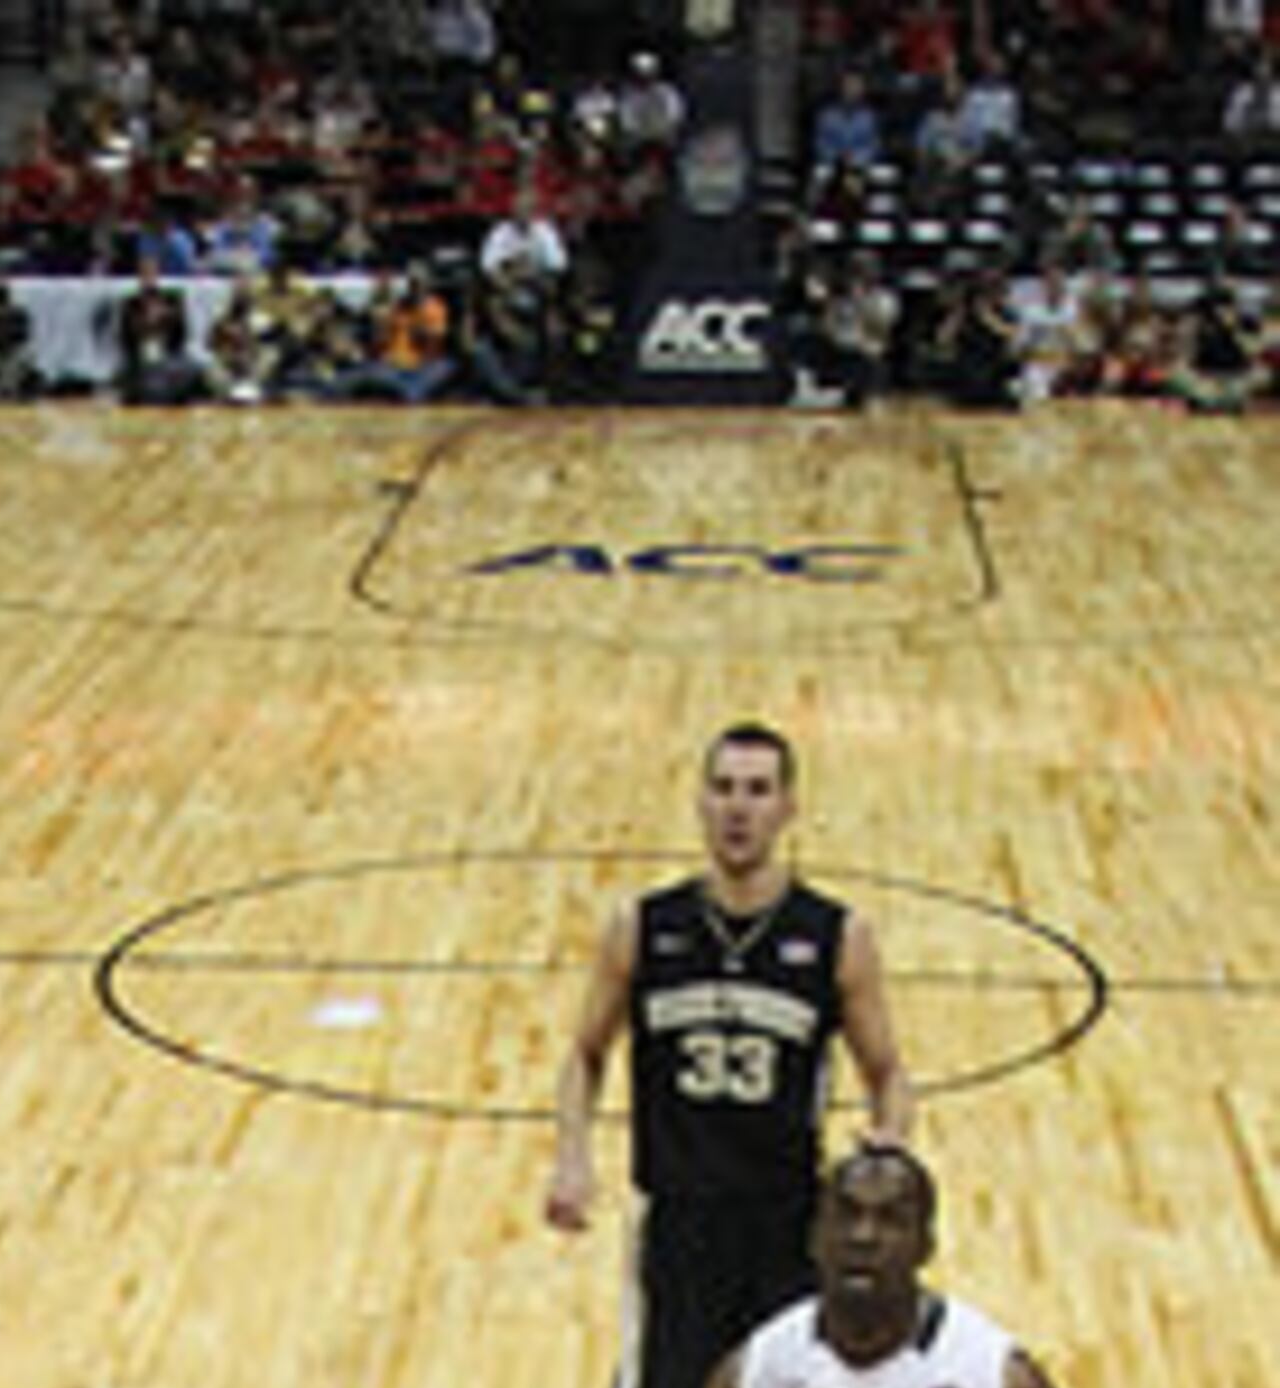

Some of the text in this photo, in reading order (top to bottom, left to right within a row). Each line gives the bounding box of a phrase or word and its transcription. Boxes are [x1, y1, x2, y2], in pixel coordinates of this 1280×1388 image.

[640, 300, 770, 368] ACC
[460, 542, 912, 580] ACC
[676, 1033, 780, 1101] 33
